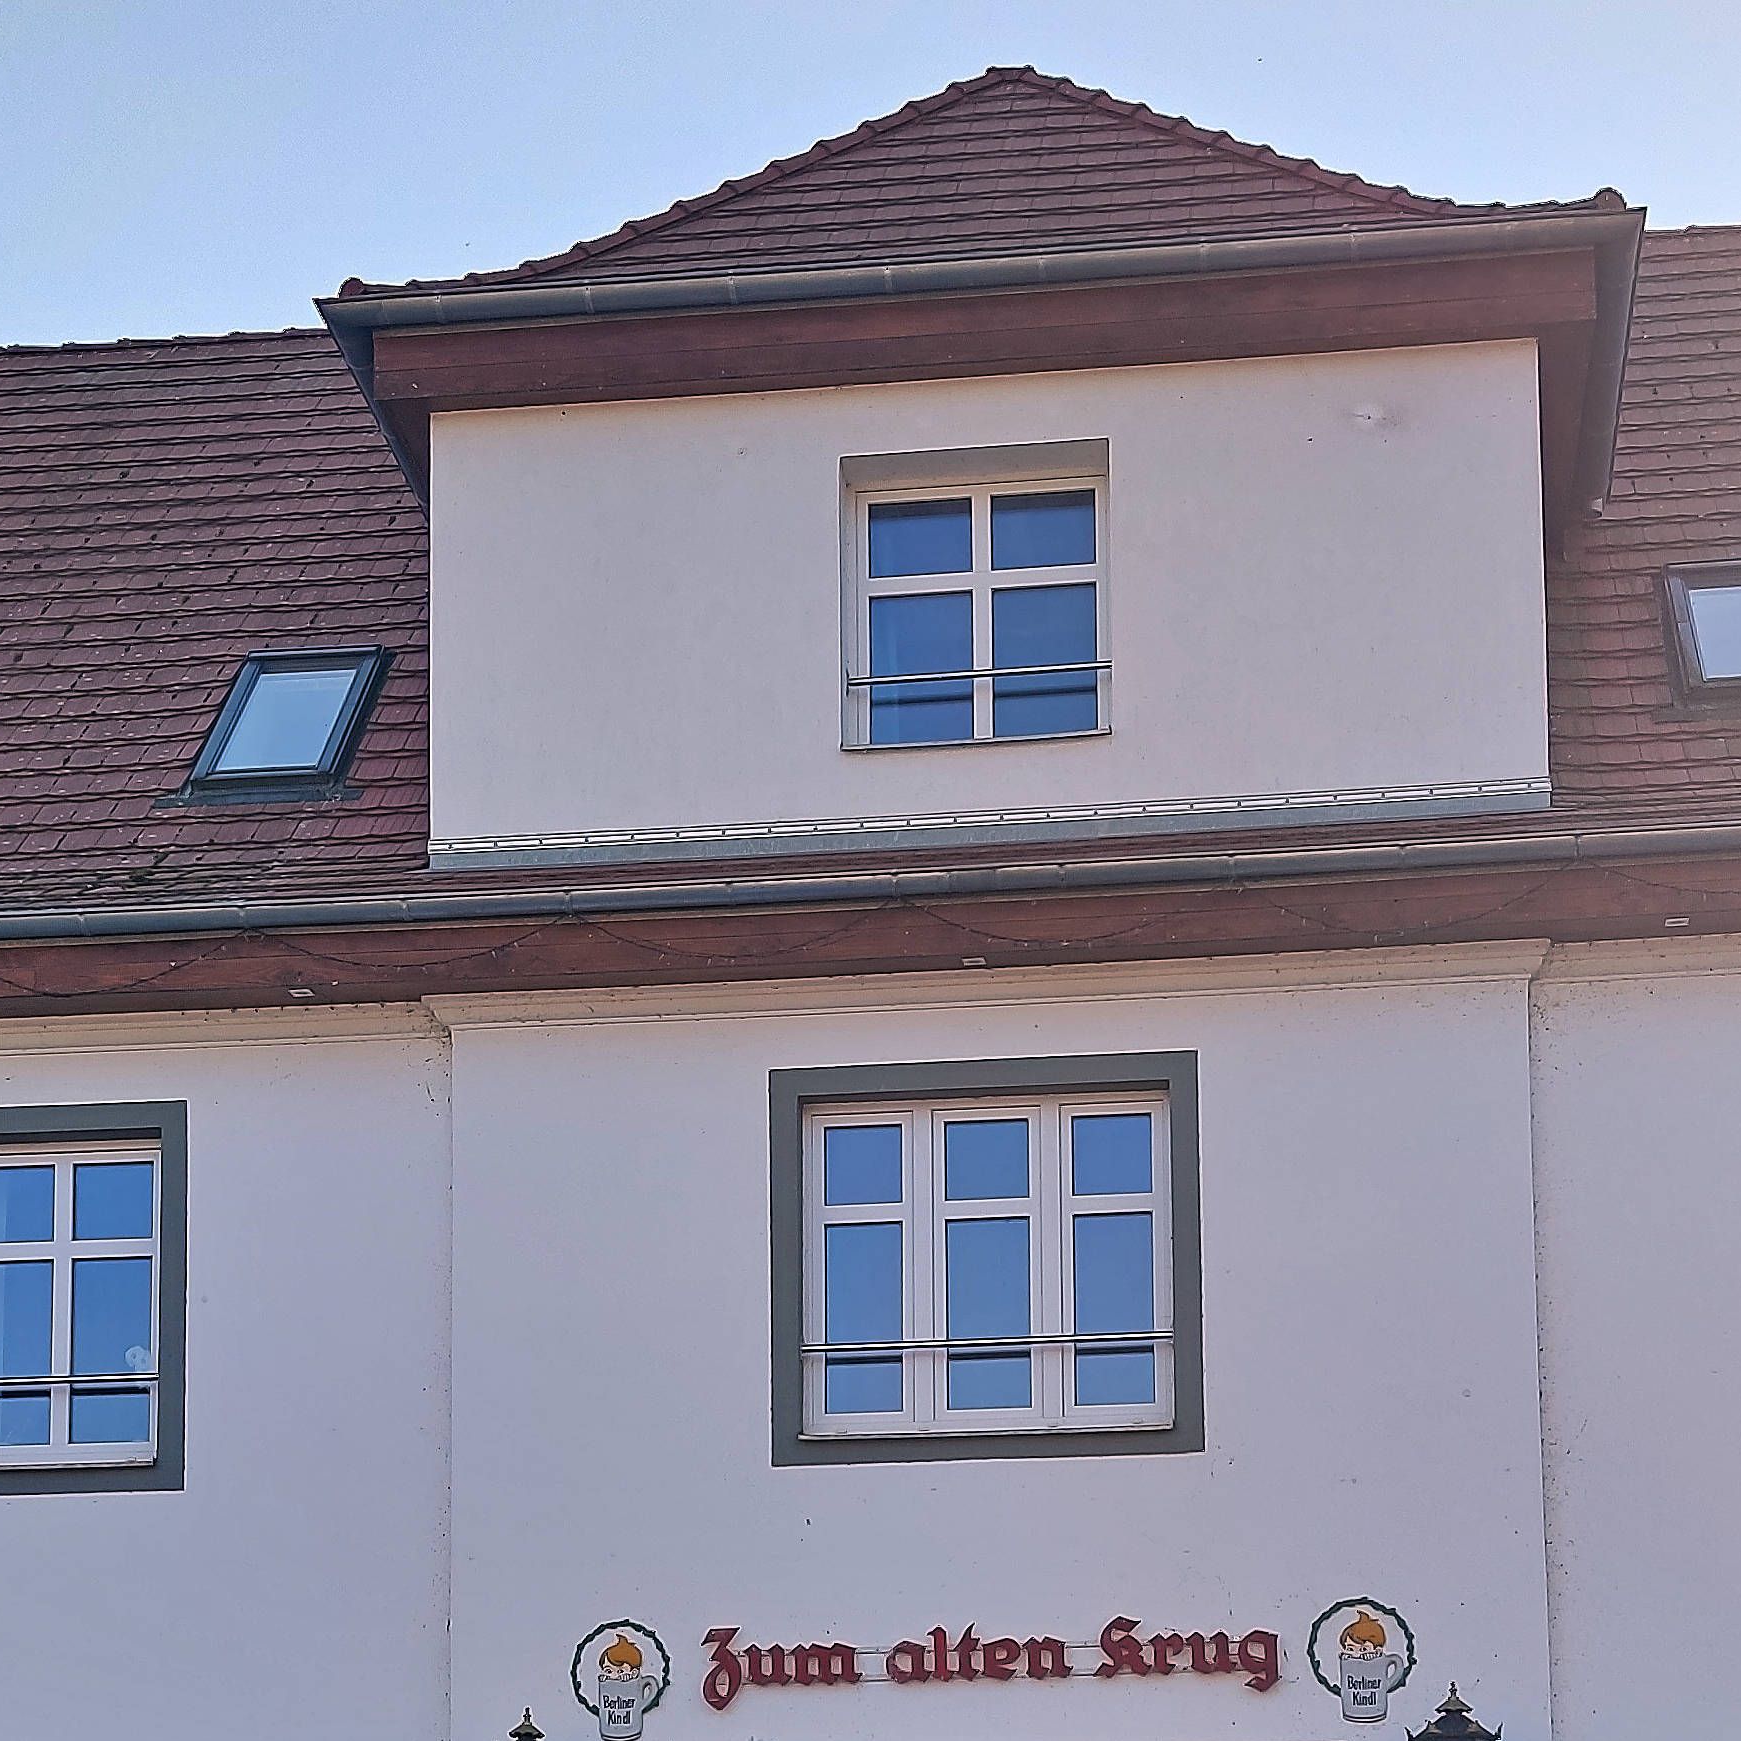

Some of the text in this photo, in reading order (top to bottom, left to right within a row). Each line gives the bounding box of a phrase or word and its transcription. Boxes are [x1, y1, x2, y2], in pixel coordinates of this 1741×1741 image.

[700, 1615, 1280, 1711] Zum alten Krug
[1347, 1675, 1382, 1690] Berliner
[602, 1694, 636, 1710] Berliner
[1352, 1691, 1377, 1706] Kindl
[607, 1709, 631, 1726] Kindl
